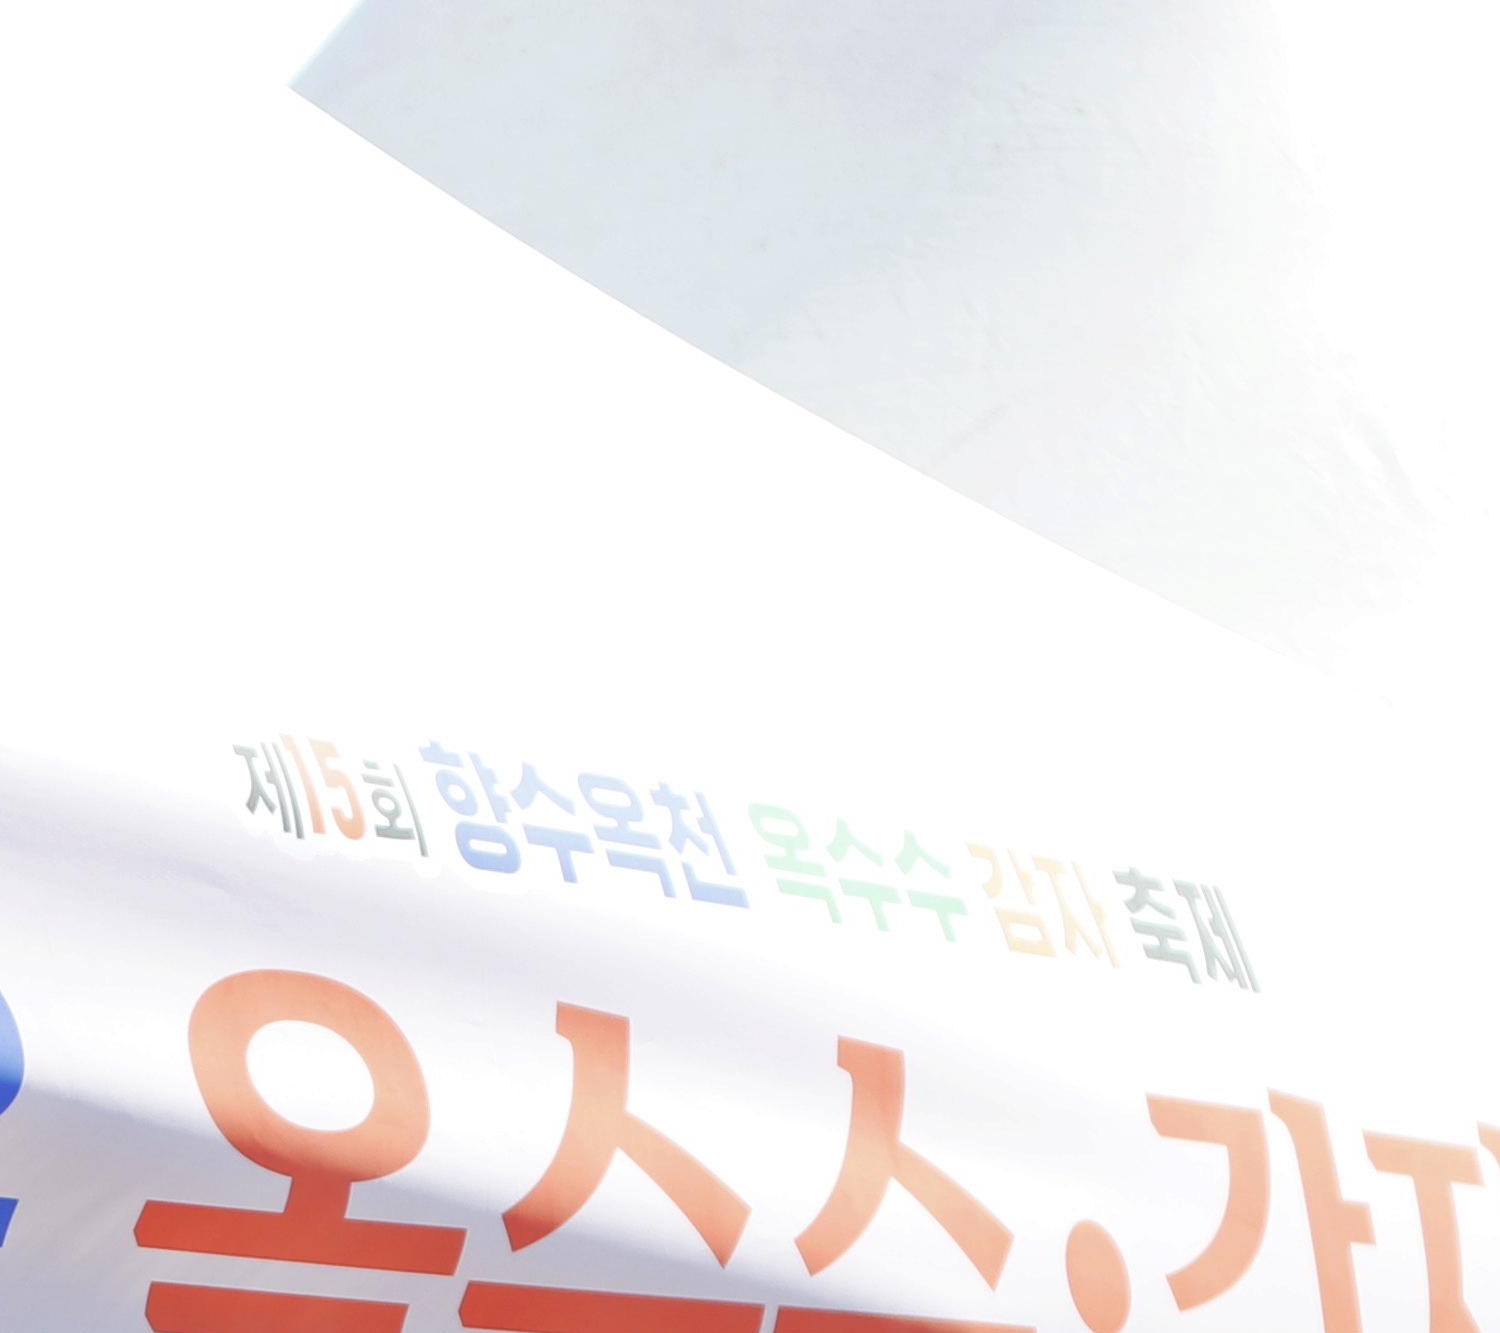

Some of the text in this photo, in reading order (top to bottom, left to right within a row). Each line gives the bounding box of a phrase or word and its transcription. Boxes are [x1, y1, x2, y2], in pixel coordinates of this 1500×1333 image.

[233, 734, 1260, 993] 제15회 향수옥천 옥수수 감자 축제
